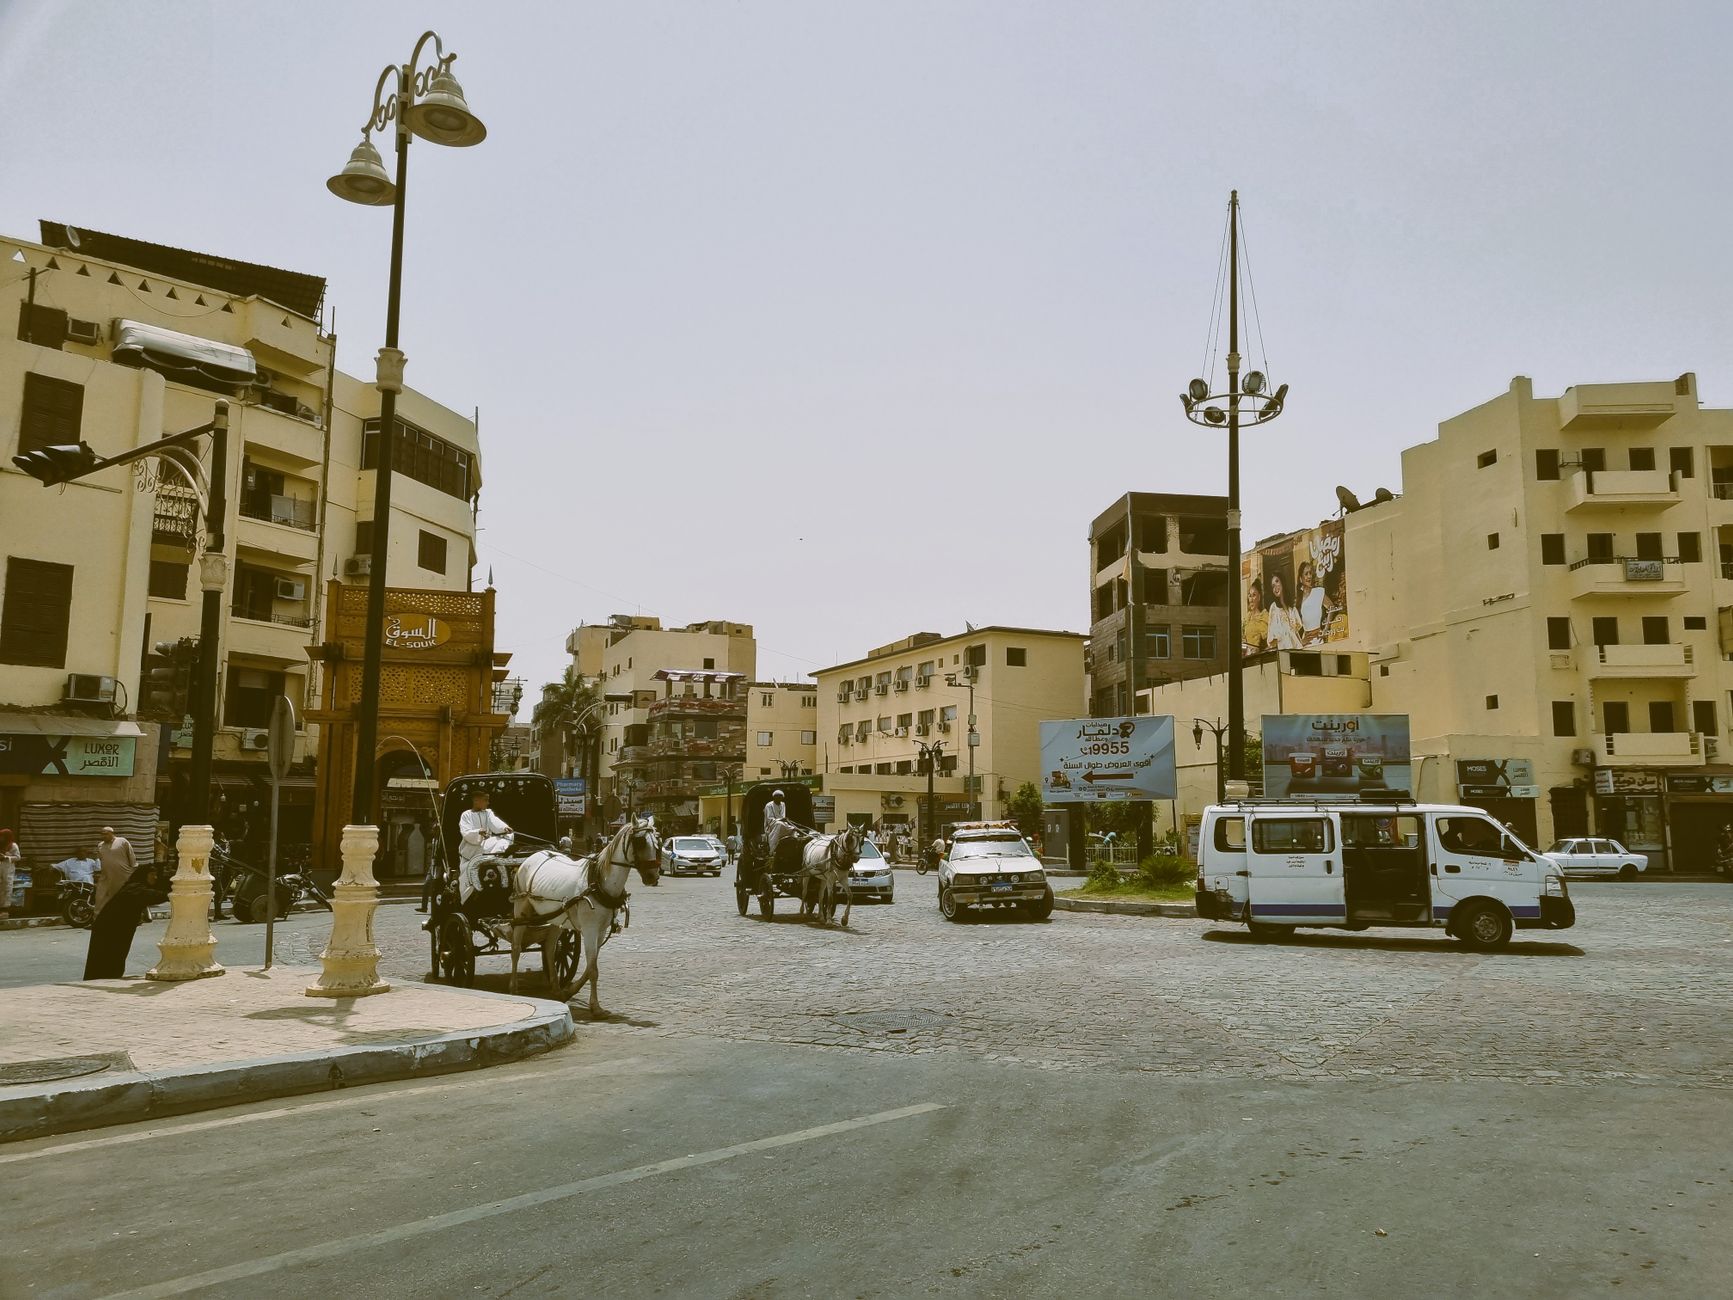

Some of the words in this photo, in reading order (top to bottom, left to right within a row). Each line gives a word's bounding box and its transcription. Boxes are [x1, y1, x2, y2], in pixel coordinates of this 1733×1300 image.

[385, 616, 437, 639] السوق
[385, 638, 437, 648] EL-SOUK
[1311, 717, 1360, 732] أورينت
[1076, 724, 1120, 739] دلمار
[84, 744, 120, 755] LUXOR
[1089, 741, 1130, 755] 19955
[80, 756, 119, 770] الأقصر
[1063, 761, 1083, 769] السنة
[1084, 761, 1103, 769] طوال
[1104, 760, 1132, 769] العروض
